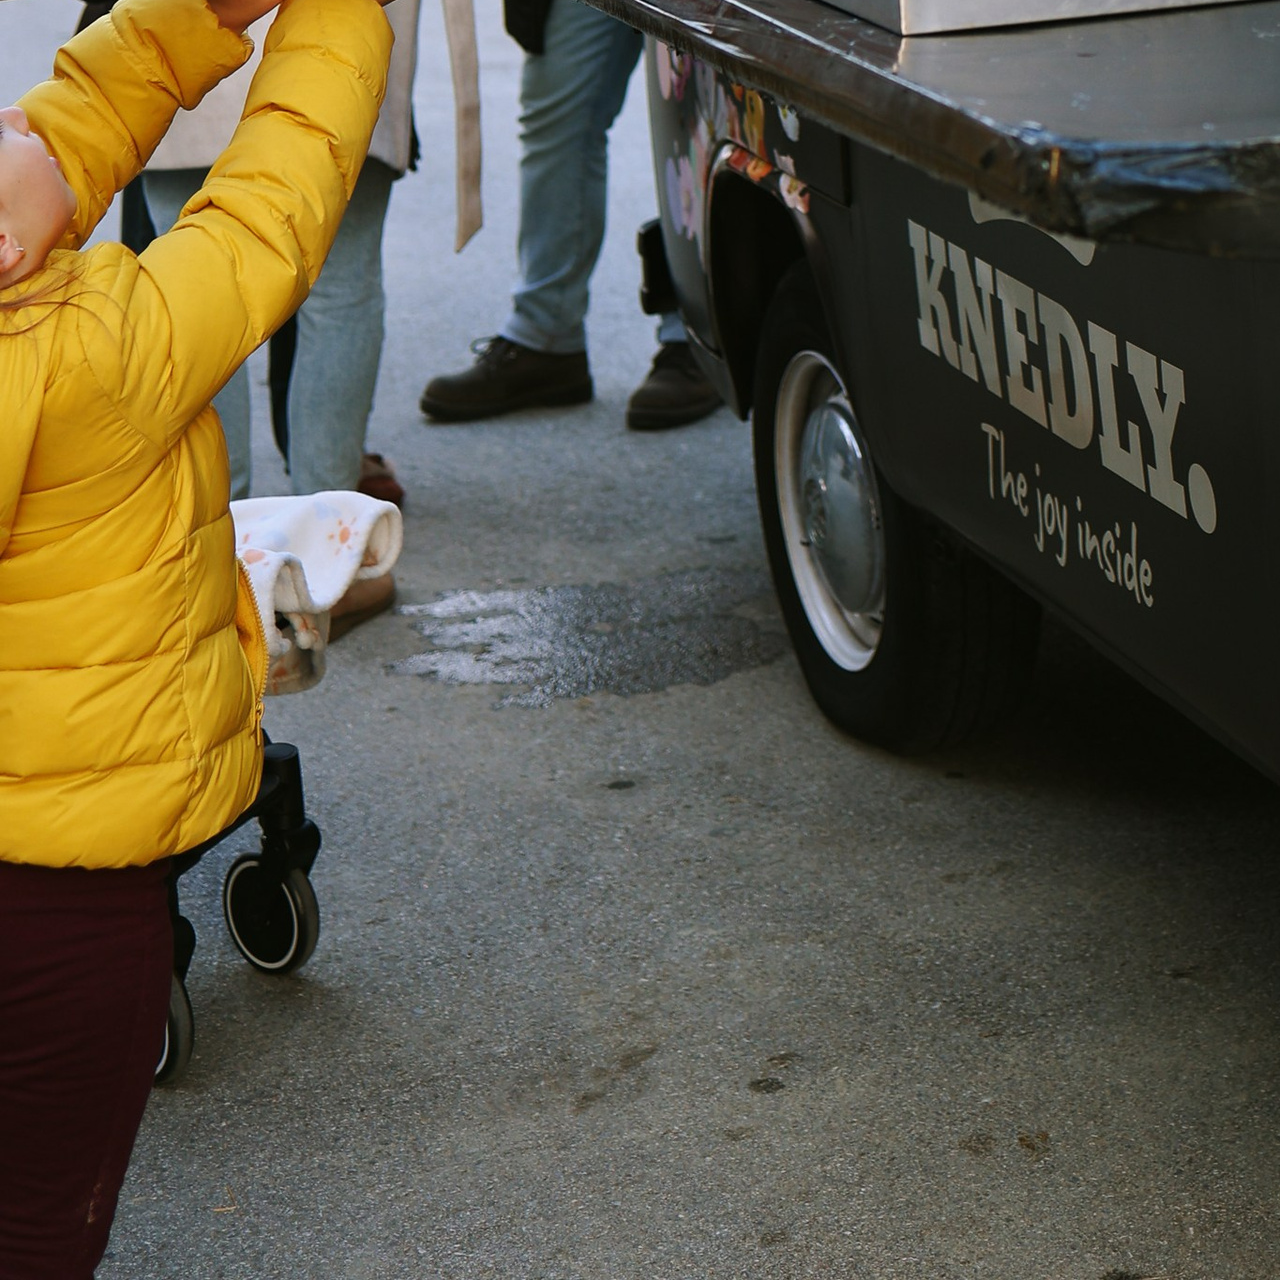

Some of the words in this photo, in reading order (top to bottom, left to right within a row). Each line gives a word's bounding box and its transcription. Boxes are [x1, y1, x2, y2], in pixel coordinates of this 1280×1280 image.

[981, 423, 1029, 517] The
[1034, 464, 1067, 567] joy
[1076, 496, 1153, 607] inside
